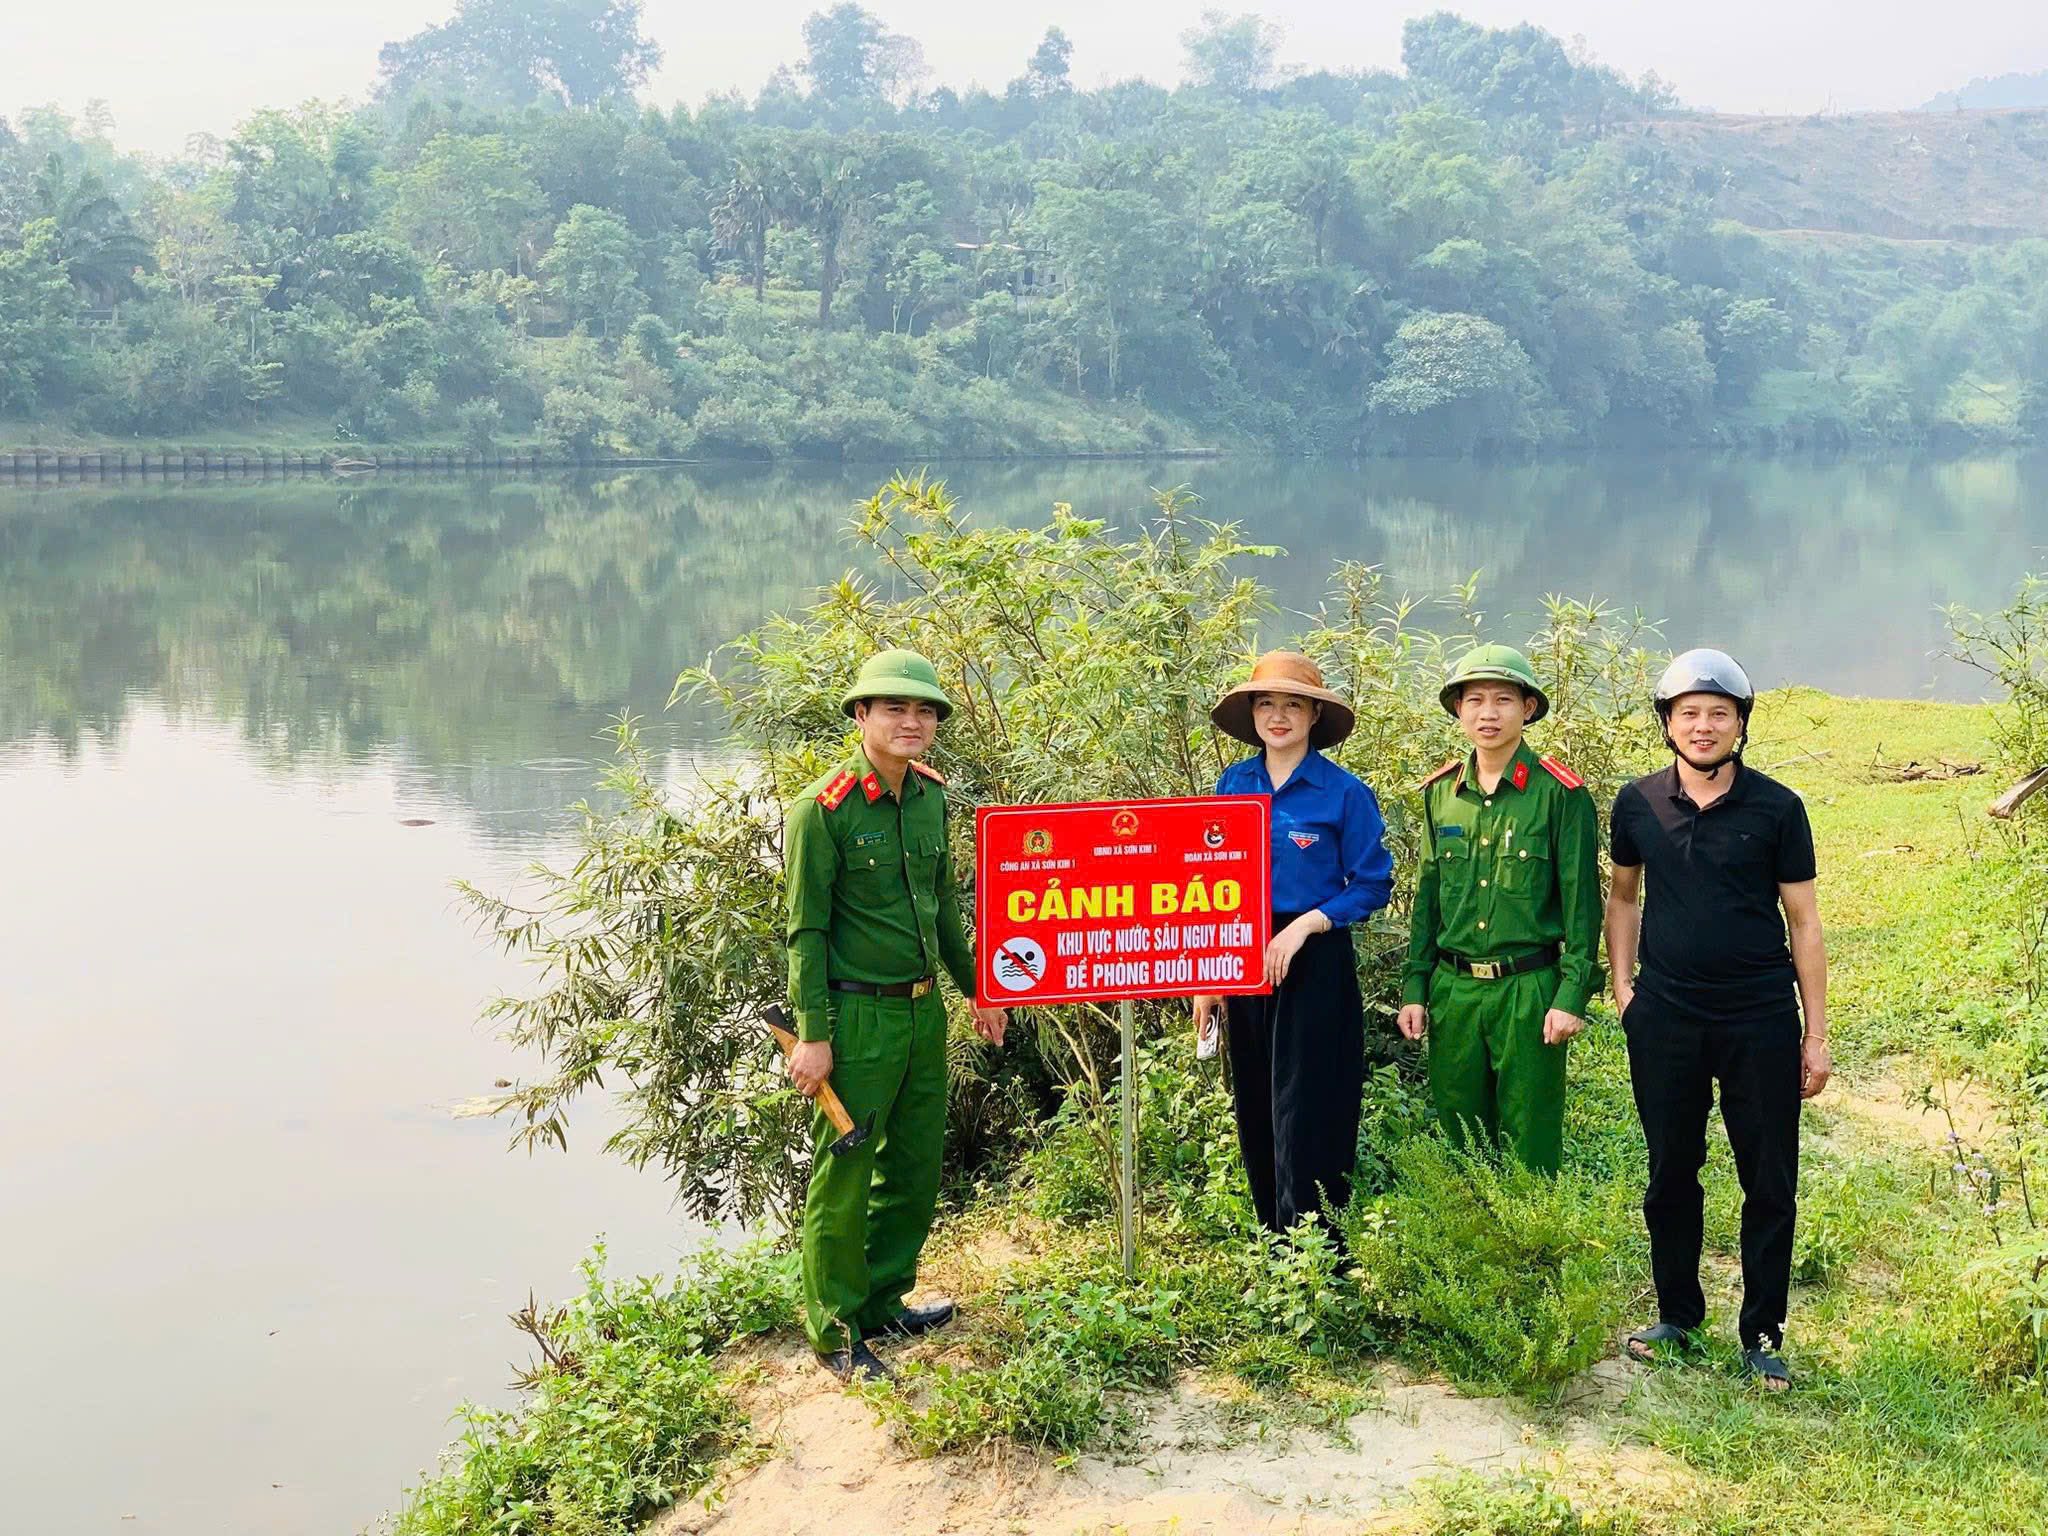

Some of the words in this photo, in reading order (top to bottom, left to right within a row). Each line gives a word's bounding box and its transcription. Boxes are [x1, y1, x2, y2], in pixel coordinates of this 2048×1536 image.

[1000, 860, 1019, 872] CÔNG
[1020, 861, 1030, 871] AN
[1031, 859, 1040, 870] XÃ
[1042, 859, 1056, 870] SƠN
[1057, 859, 1070, 869] KIM
[1139, 844, 1152, 854] KIM
[1007, 877, 1134, 922] CẢNH
[1151, 874, 1241, 915] BÁO
[1057, 931, 1083, 956] KHU
[1087, 928, 1112, 959] VỰC
[1115, 923, 1150, 953] NƯỚC
[1154, 921, 1179, 951] SÂU
[1183, 924, 1217, 950] NGUY
[1219, 913, 1253, 947] HIỂM
[1066, 957, 1088, 989] ĐỀ
[1093, 957, 1150, 987] PHÒNG
[1154, 951, 1193, 983] ĐUỐI
[1198, 952, 1244, 981] NƯỚC
